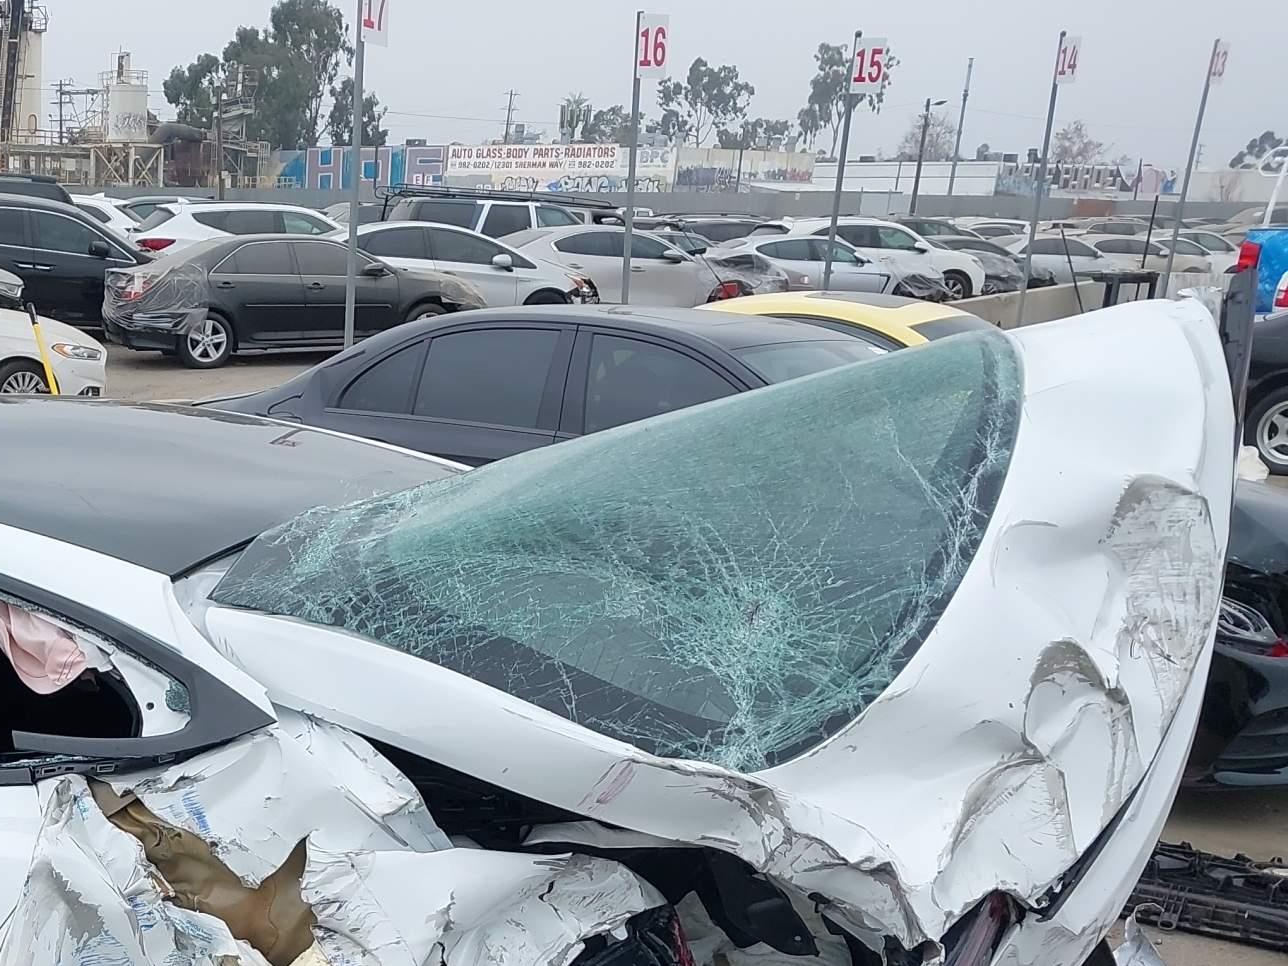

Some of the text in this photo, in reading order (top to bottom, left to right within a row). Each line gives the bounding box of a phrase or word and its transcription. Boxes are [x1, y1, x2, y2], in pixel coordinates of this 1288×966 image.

[639, 27, 667, 67] 16
[1058, 45, 1078, 75] 14
[852, 47, 884, 83] 15
[1212, 51, 1228, 77] 13
[452, 148, 473, 158] AUTO
[515, 160, 546, 169] SHERMAN
